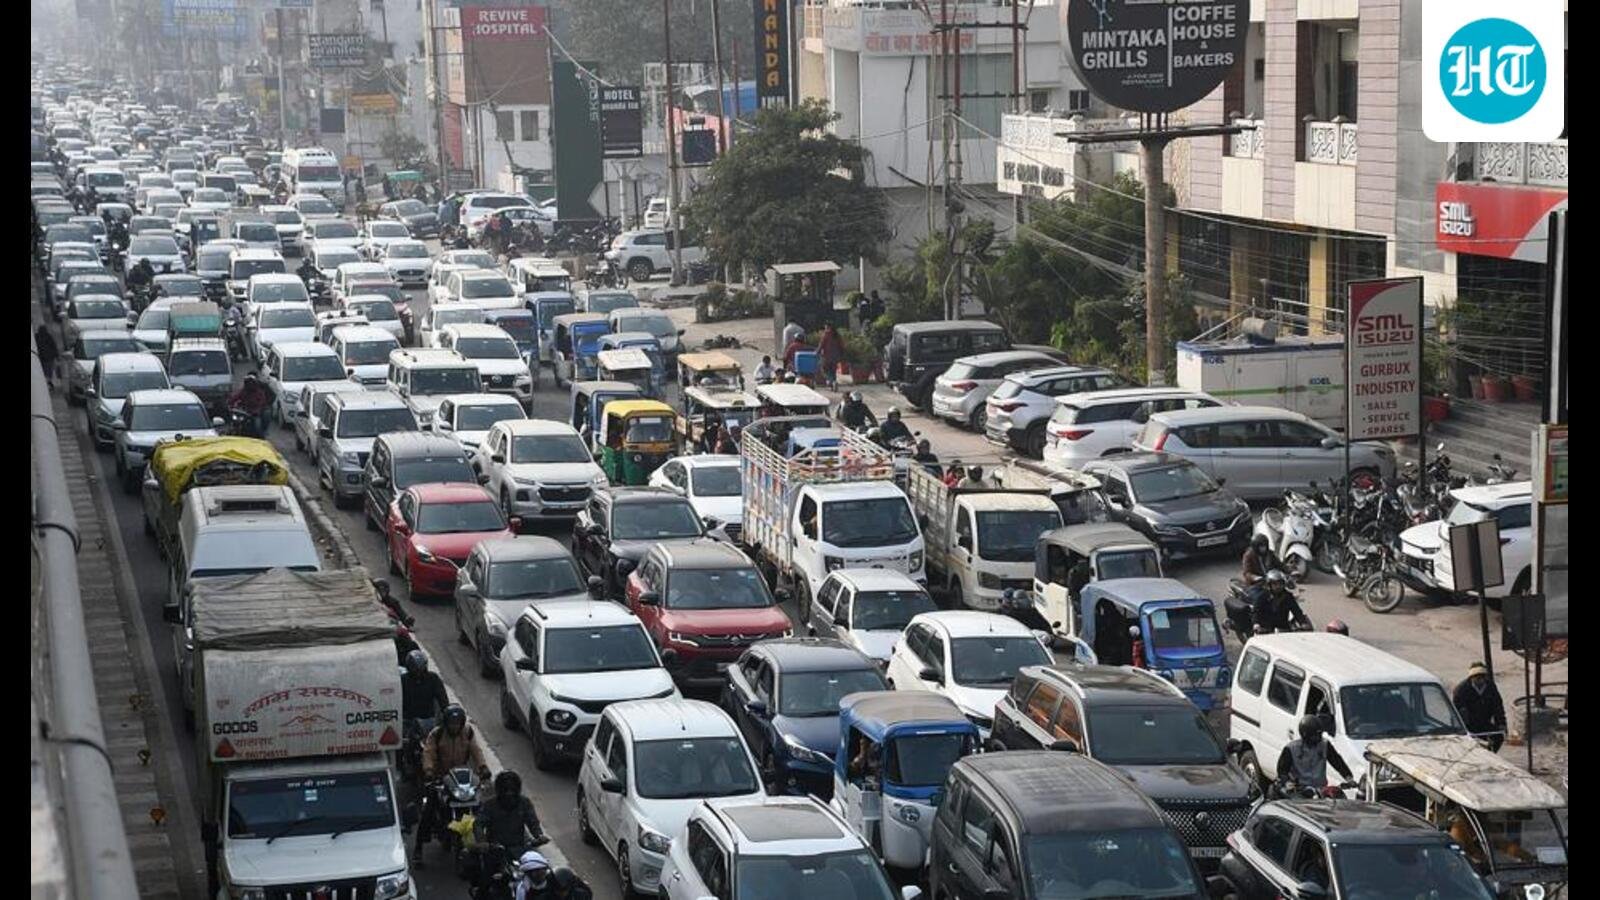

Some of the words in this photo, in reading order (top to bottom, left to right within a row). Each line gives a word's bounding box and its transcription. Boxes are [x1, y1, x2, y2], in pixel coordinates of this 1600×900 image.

[479, 10, 529, 21] REVIVE
[1174, 5, 1236, 21] COFFE
[1082, 29, 1167, 49] MINTAKA
[1173, 24, 1236, 40] HOUSE
[1082, 50, 1148, 69] GRILLS
[1173, 53, 1234, 68] BAKERS
[603, 89, 634, 100] HOTEL
[1440, 201, 1472, 221] SML
[1440, 219, 1473, 237] ISUZU
[1358, 314, 1413, 332] SML
[1358, 330, 1413, 345] ISUZU
[1360, 361, 1410, 377] GURBUX
[1355, 380, 1416, 396] INDUSTRY
[213, 720, 258, 735] GOODS
[346, 709, 399, 725] CARRIER
